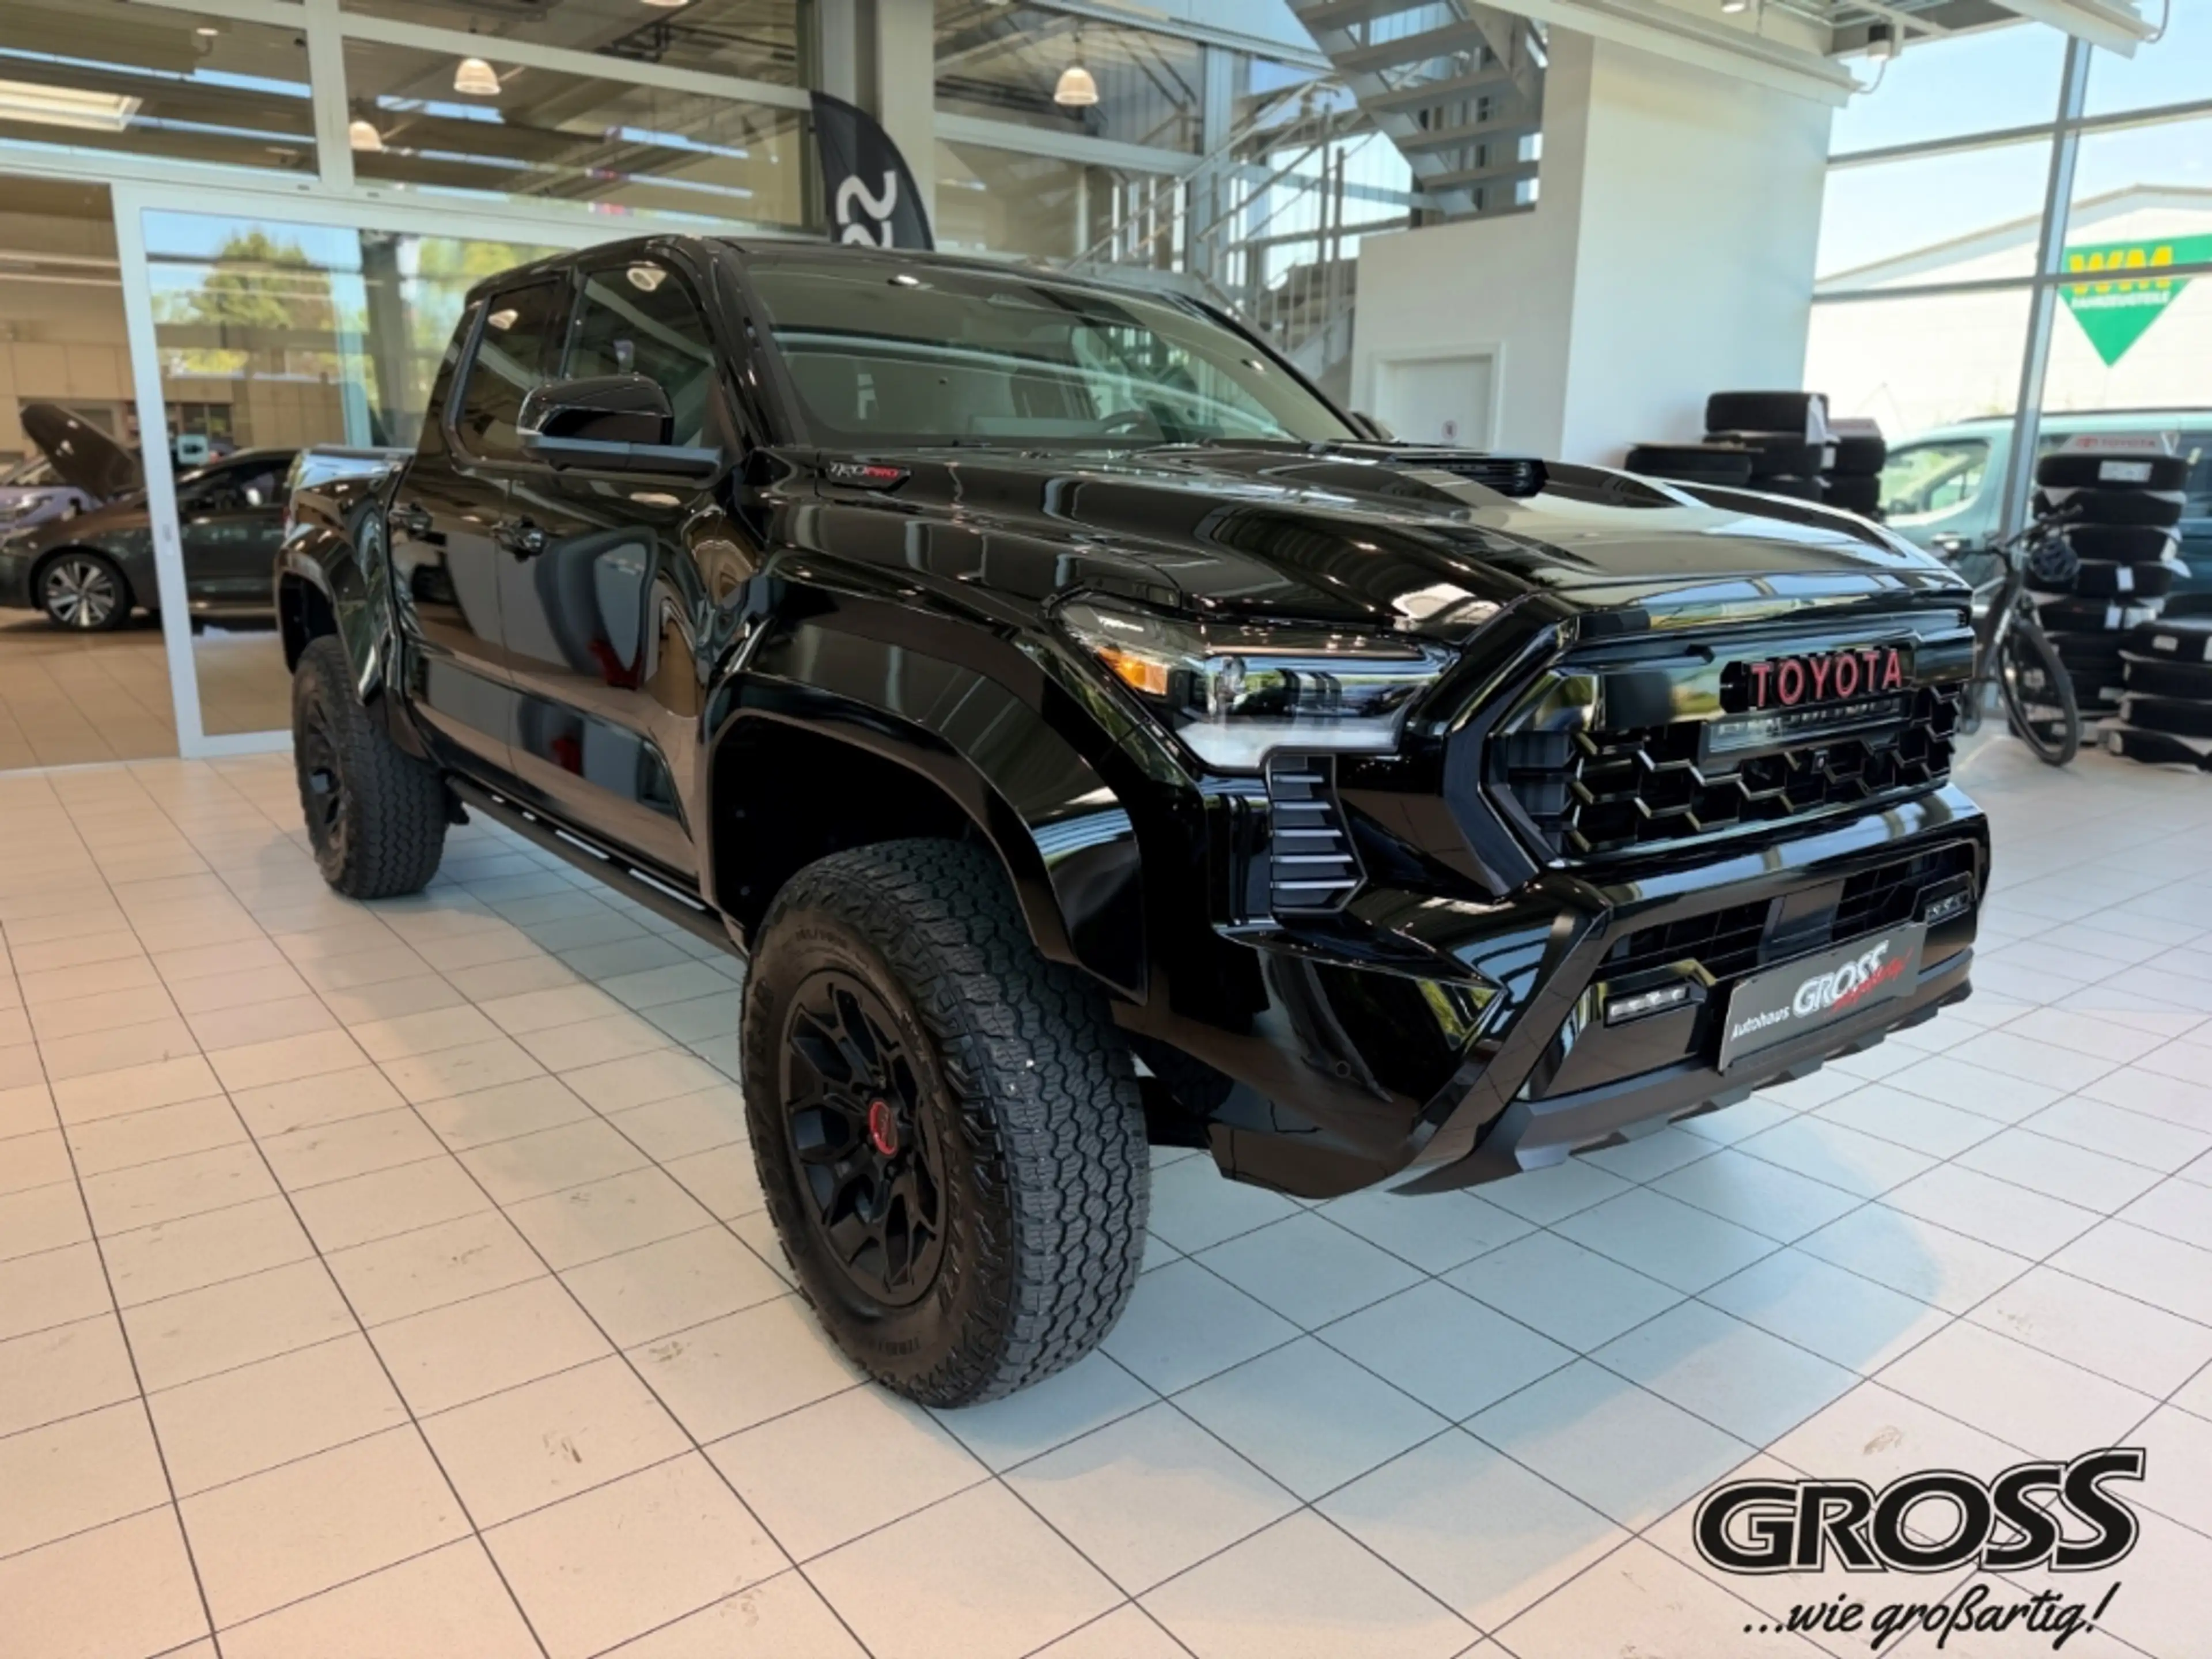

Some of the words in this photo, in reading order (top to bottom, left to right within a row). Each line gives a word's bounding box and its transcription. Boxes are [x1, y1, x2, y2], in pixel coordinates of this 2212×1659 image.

[1750, 647, 1902, 708] TOYOTA
[1730, 1006, 1789, 1041] Autohaus
[1793, 938, 1889, 1018] GROSS
